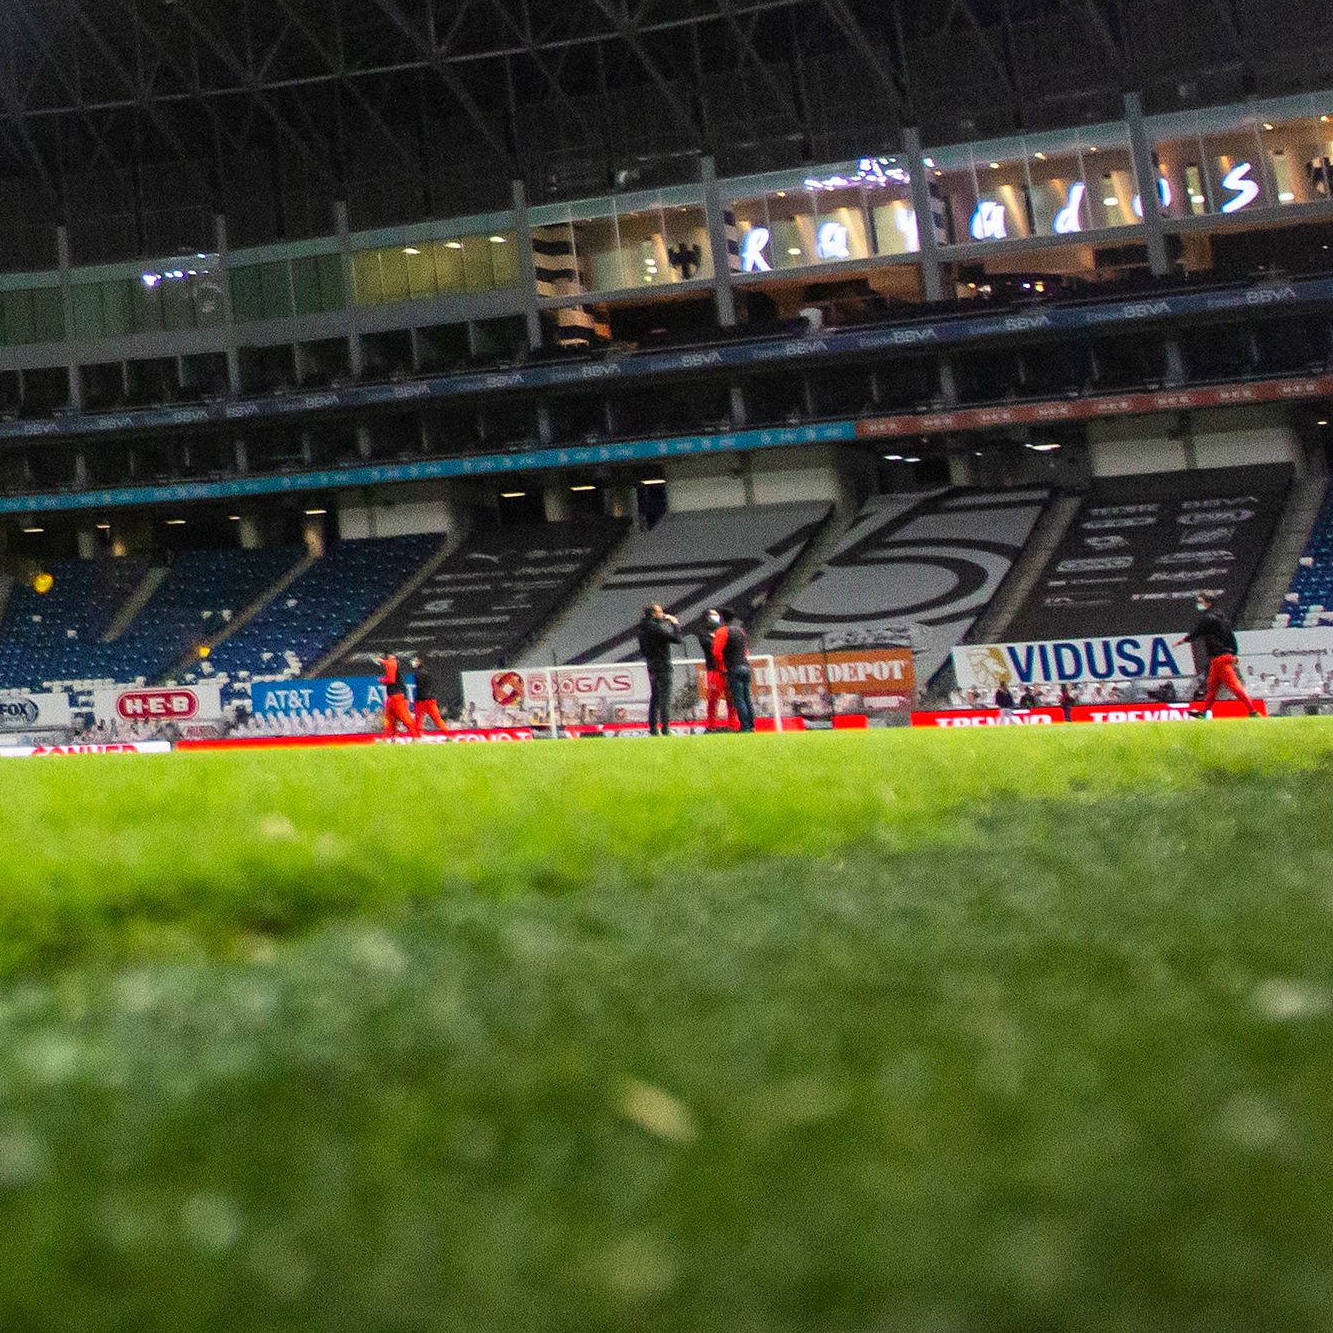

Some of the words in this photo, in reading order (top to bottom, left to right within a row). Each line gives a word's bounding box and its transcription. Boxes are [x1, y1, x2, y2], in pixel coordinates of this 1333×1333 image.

[1245, 286, 1297, 305] BBVA
[1007, 635, 1181, 683] VIDUSA
[828, 660, 905, 683] DEPOT
[265, 689, 314, 710] AT&T
[367, 682, 418, 707] ATT
[0, 703, 28, 717] FOX
[125, 697, 191, 715] H-E-B
